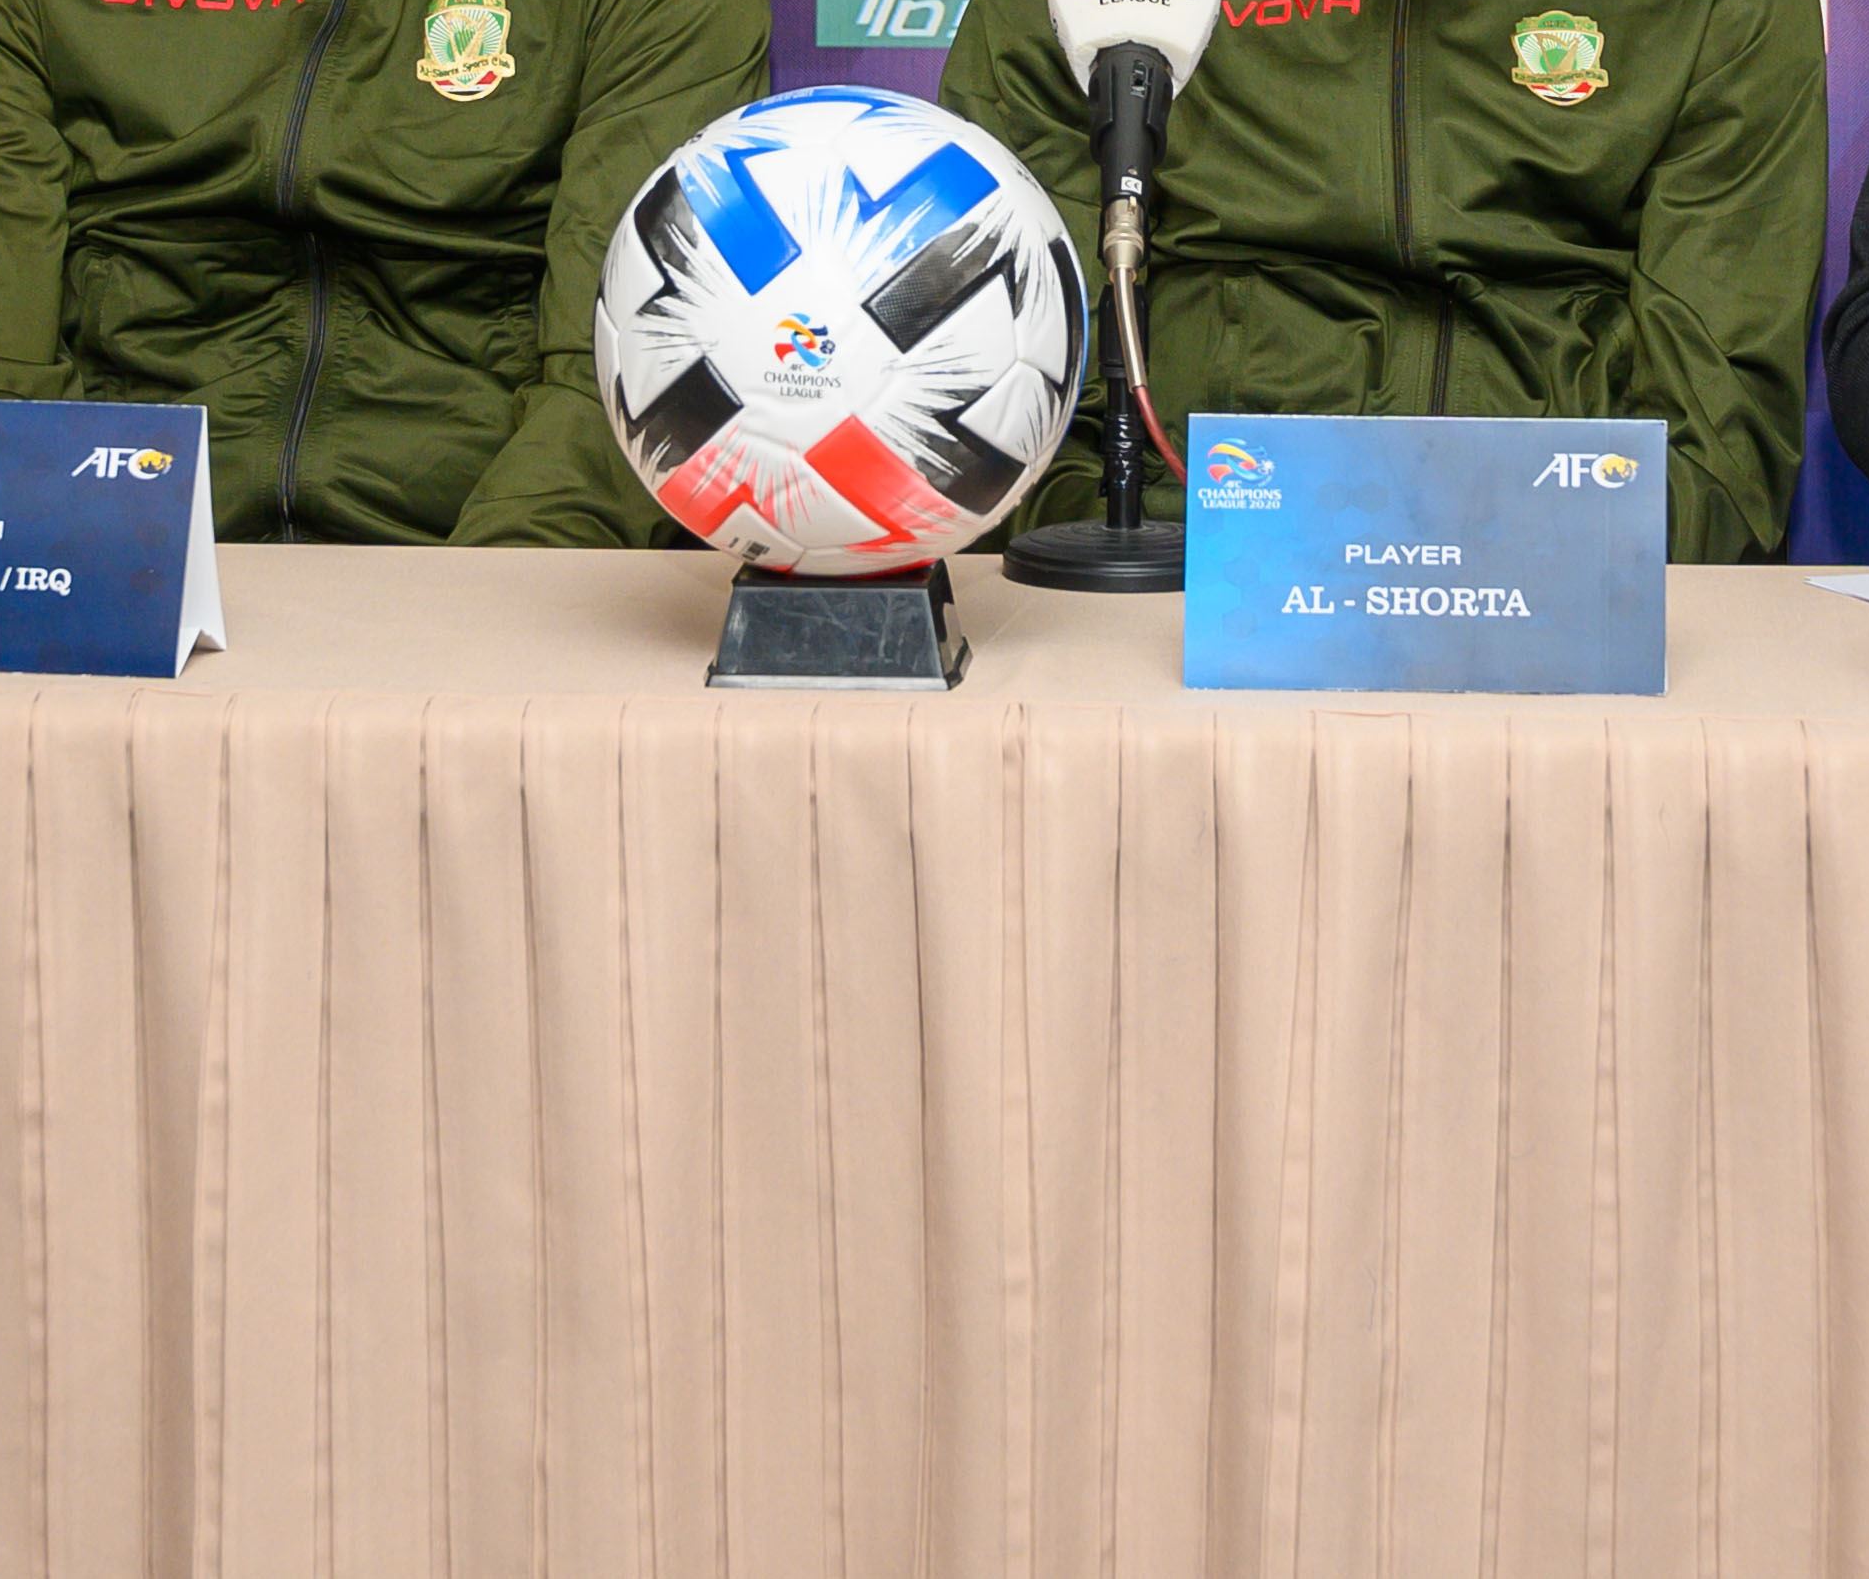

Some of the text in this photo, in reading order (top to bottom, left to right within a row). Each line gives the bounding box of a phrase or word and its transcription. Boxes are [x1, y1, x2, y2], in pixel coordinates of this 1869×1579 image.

[764, 371, 841, 388] CHAMPIONS
[780, 386, 824, 399] LEAGUE
[72, 447, 160, 480] AFC
[1533, 454, 1625, 489] AFC
[1198, 488, 1282, 502] CHAMPIONS
[1346, 545, 1461, 565] PLAYER
[15, 568, 71, 595] IRQ
[1282, 586, 1530, 616] AL SHORTA
